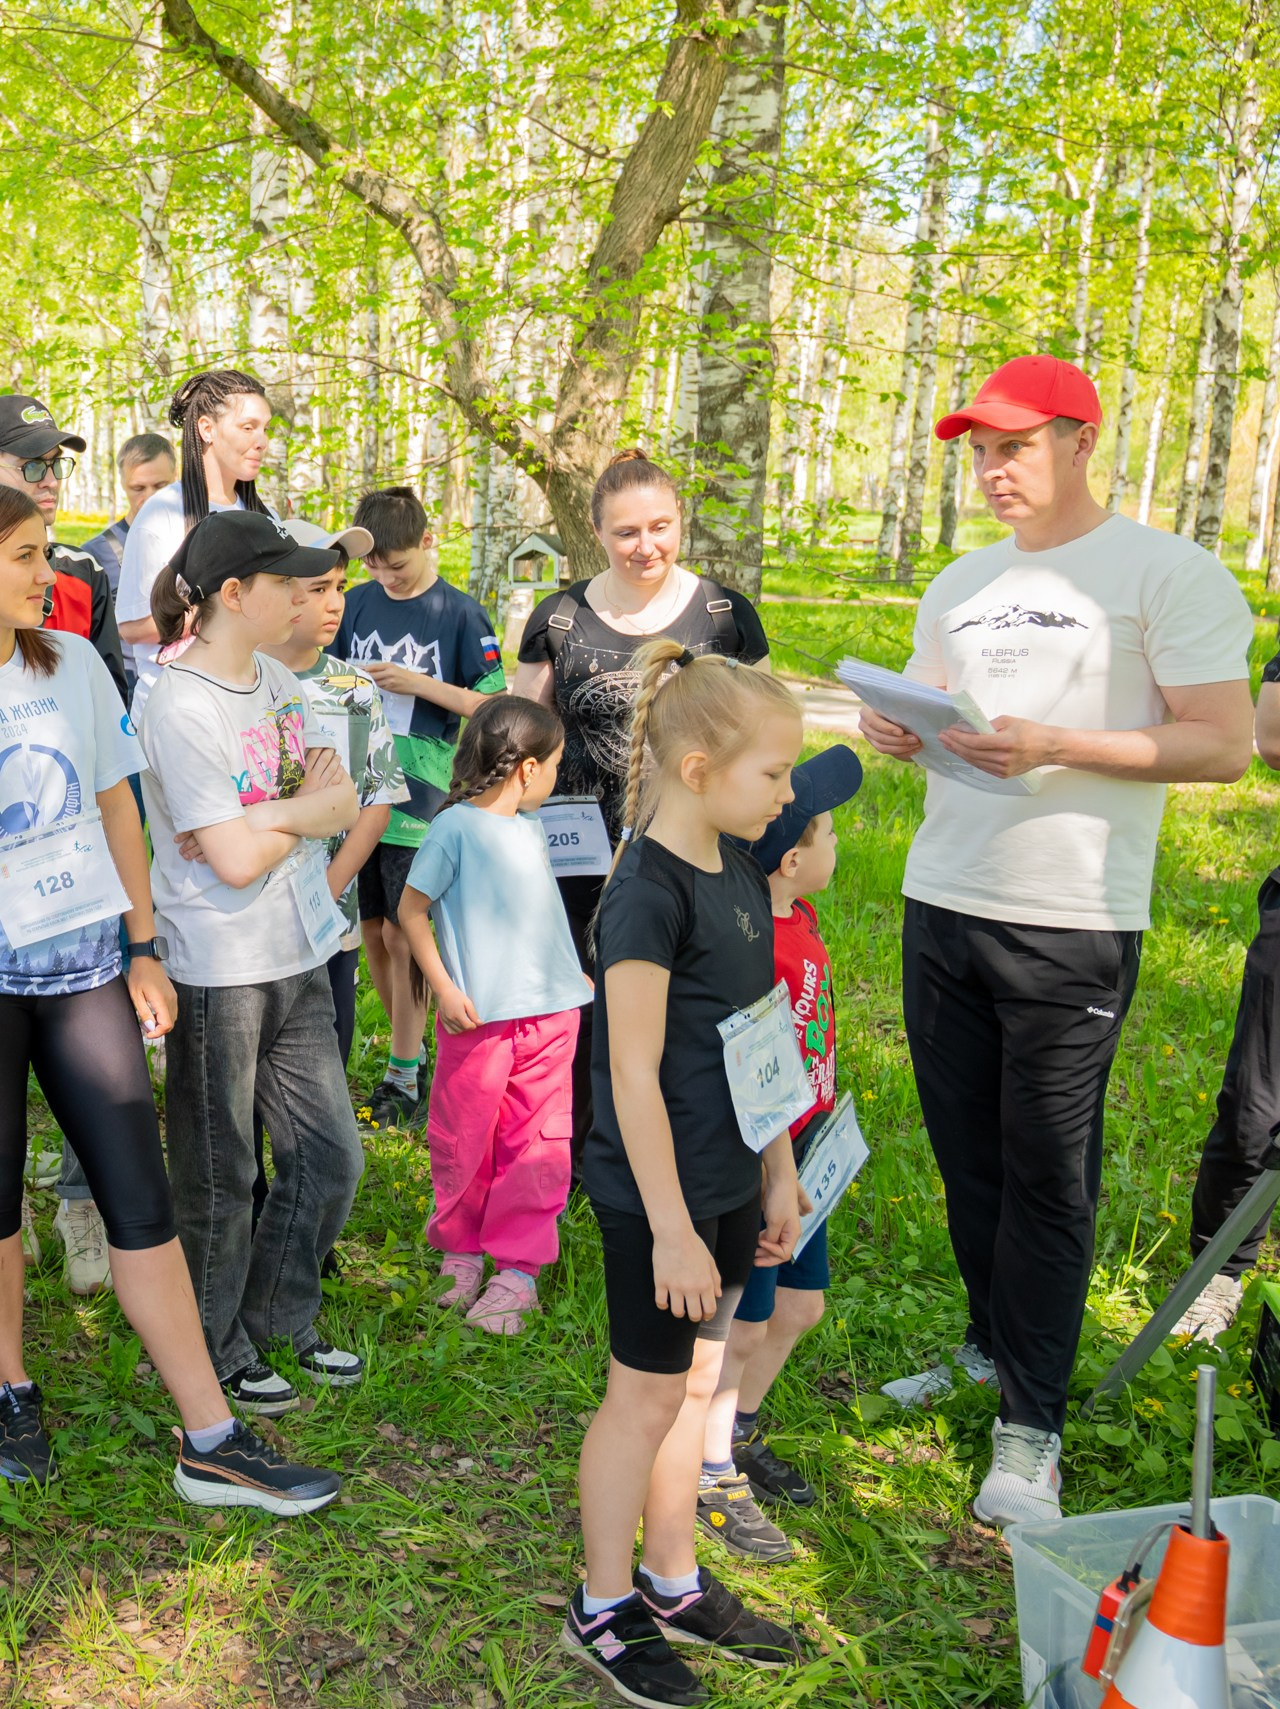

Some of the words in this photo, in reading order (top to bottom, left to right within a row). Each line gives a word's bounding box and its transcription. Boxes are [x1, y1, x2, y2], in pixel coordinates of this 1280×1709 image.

[981, 648, 1029, 657] ELBRUS
[9, 697, 59, 721] ЖИЗНИ
[1, 723, 28, 739] 2024
[548, 832, 580, 847] 205
[33, 871, 75, 897] 128
[309, 890, 321, 913] 113
[757, 1055, 780, 1089] 104
[814, 1159, 837, 1201] 135
[726, 1489, 748, 1501] BIKER
